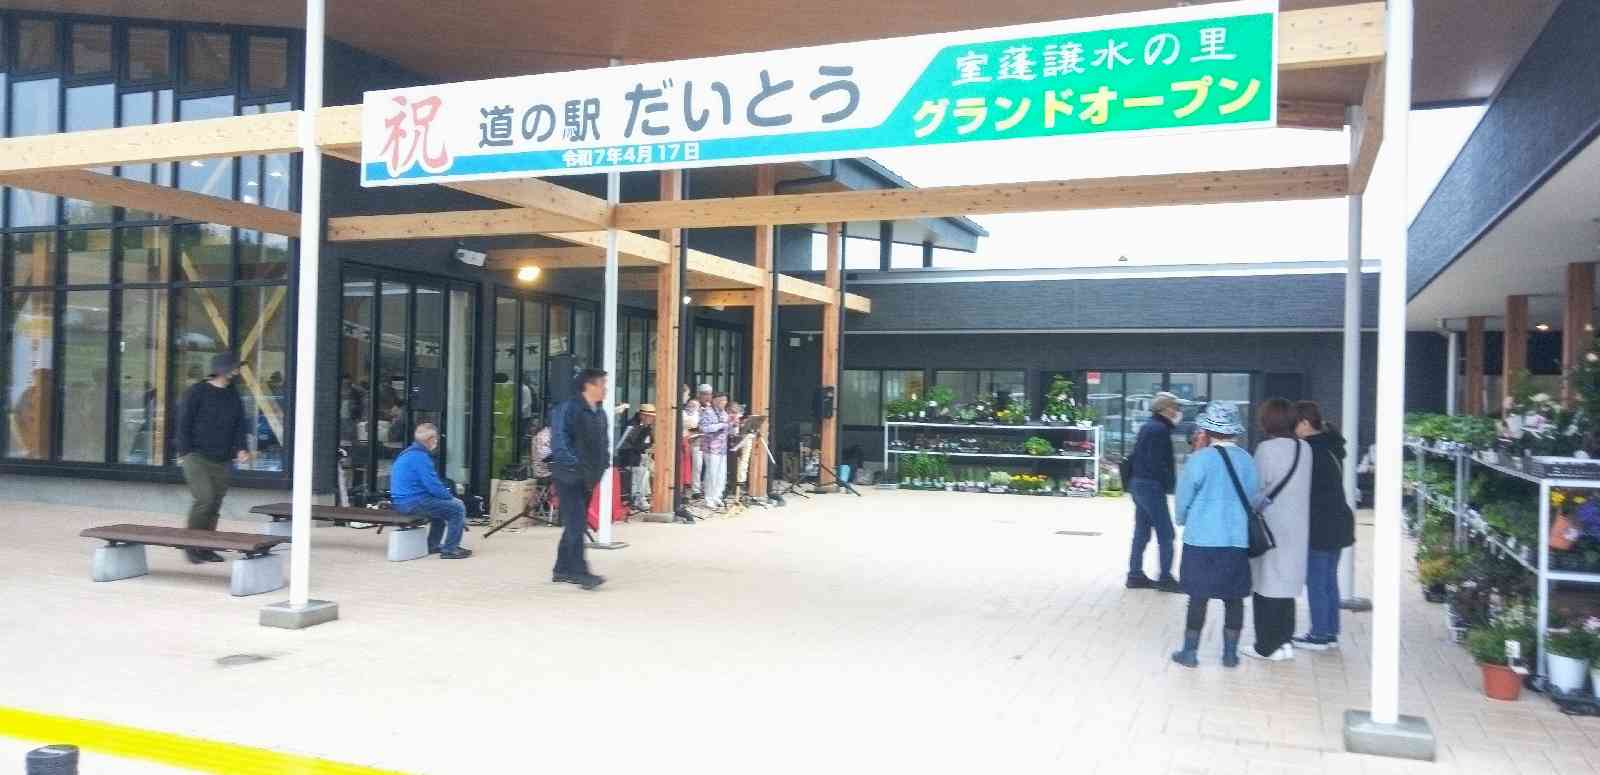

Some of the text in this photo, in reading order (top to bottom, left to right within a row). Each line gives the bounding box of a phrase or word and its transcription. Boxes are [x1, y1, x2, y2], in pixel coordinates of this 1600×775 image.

[379, 94, 449, 172] 祝
[479, 65, 861, 148] 道の駅 だいとう
[912, 75, 1261, 138] グランドオープン
[562, 141, 700, 168] 令和7年4月17日
